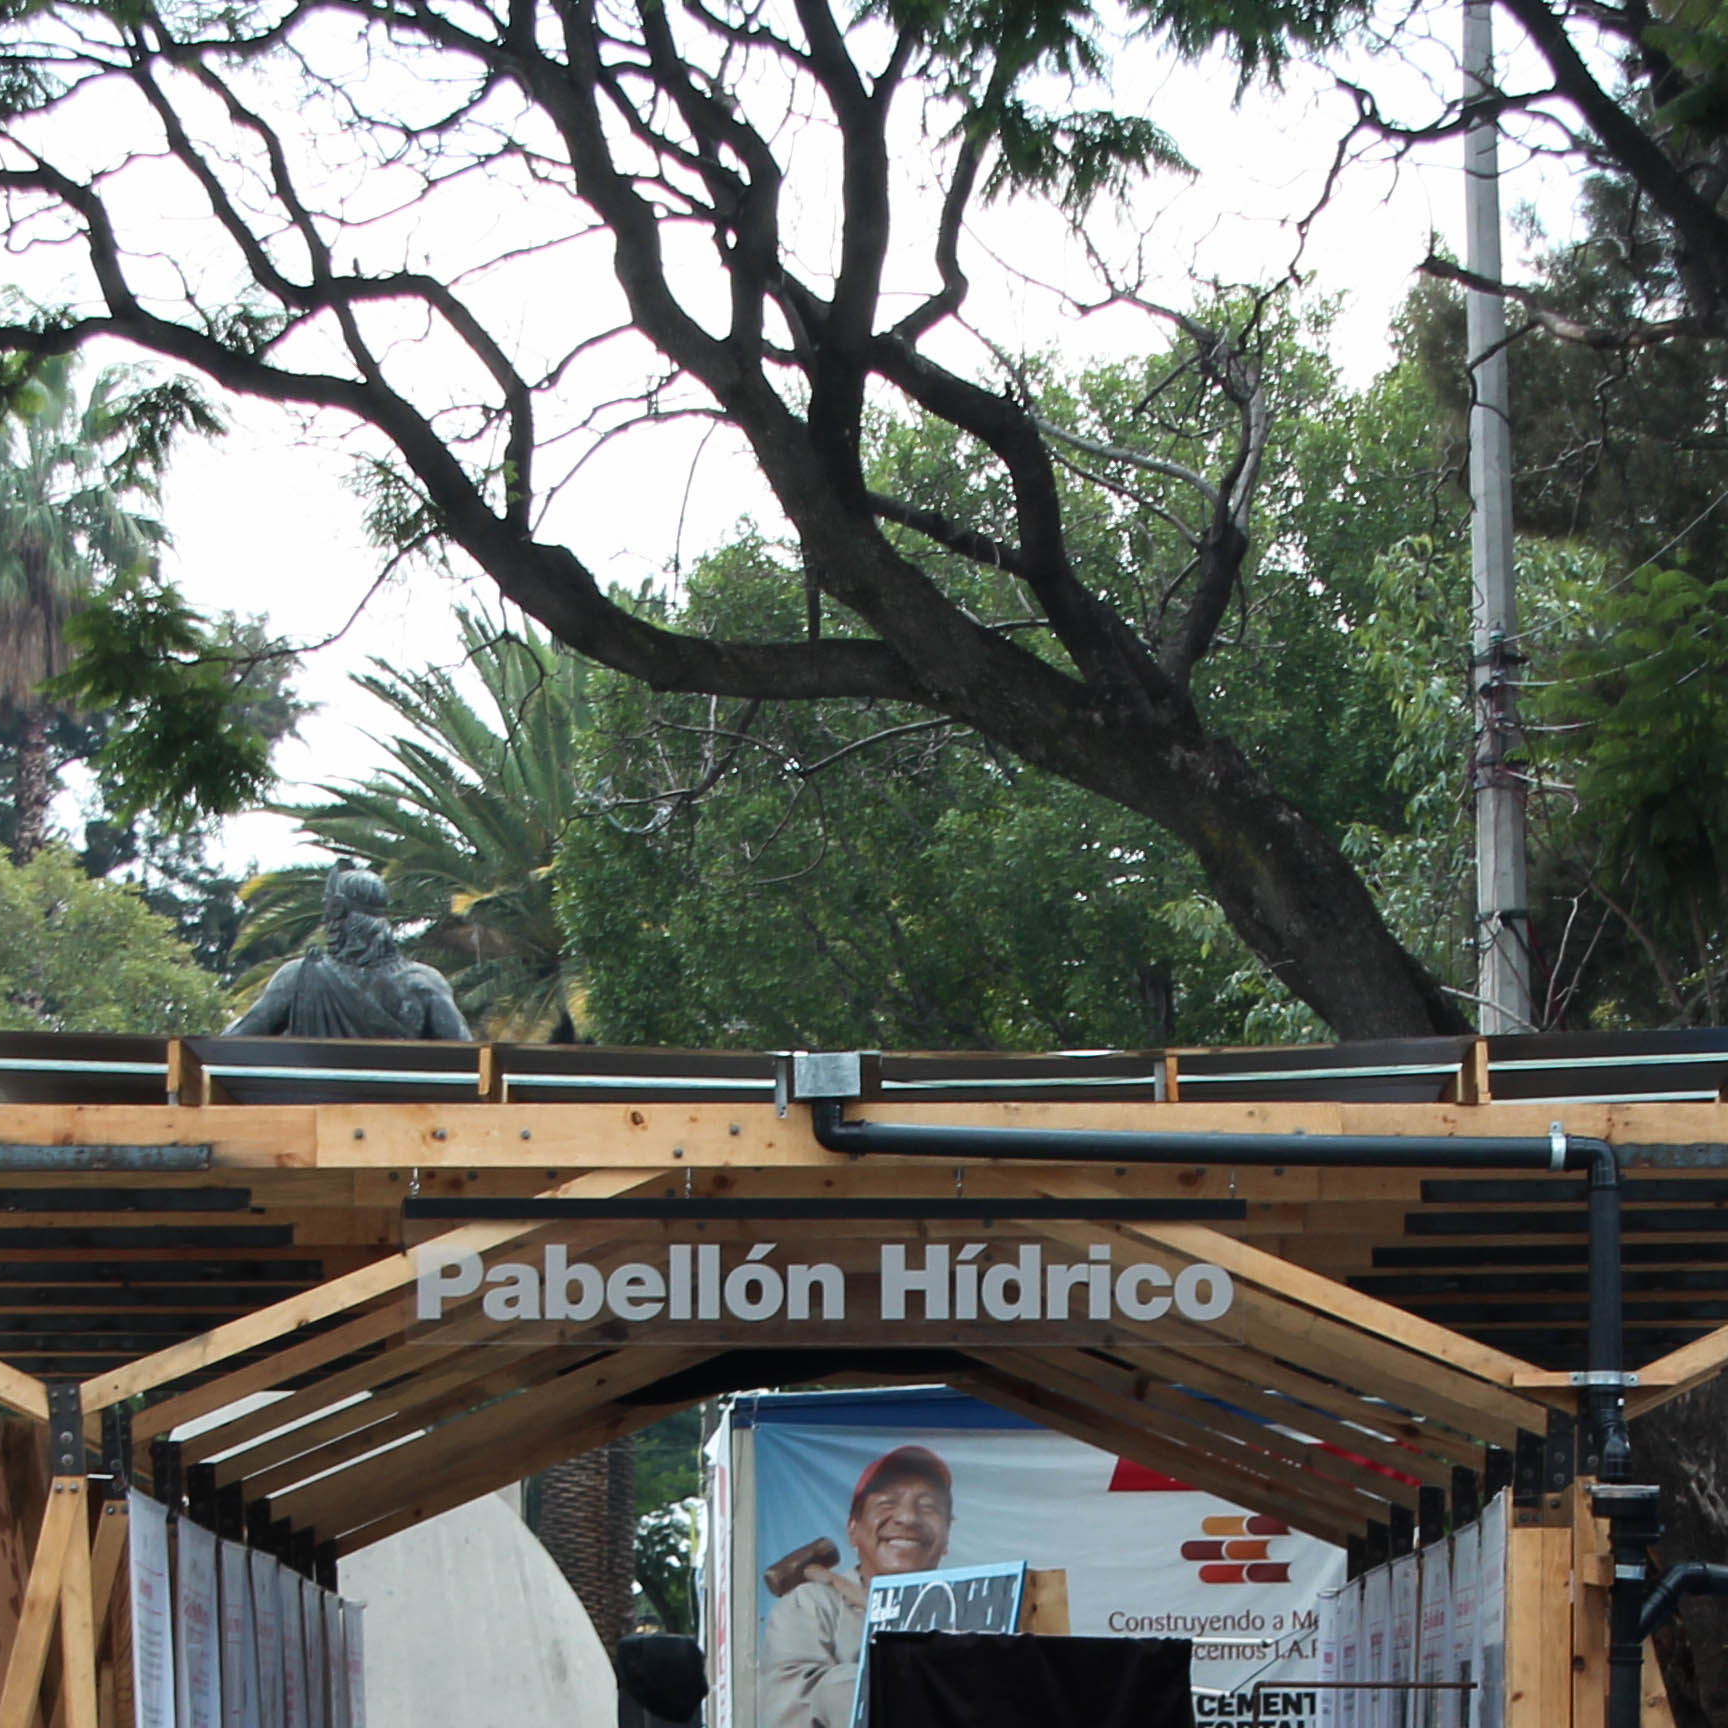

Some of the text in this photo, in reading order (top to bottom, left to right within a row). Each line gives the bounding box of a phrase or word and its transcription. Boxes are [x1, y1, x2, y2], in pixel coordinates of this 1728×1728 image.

[416, 1243, 1235, 1321] Pabellón Hídrico
[1108, 1609, 1265, 1635] Construyendo
[1273, 1618, 1284, 1631] a
[1189, 1644, 1267, 1661] cemos
